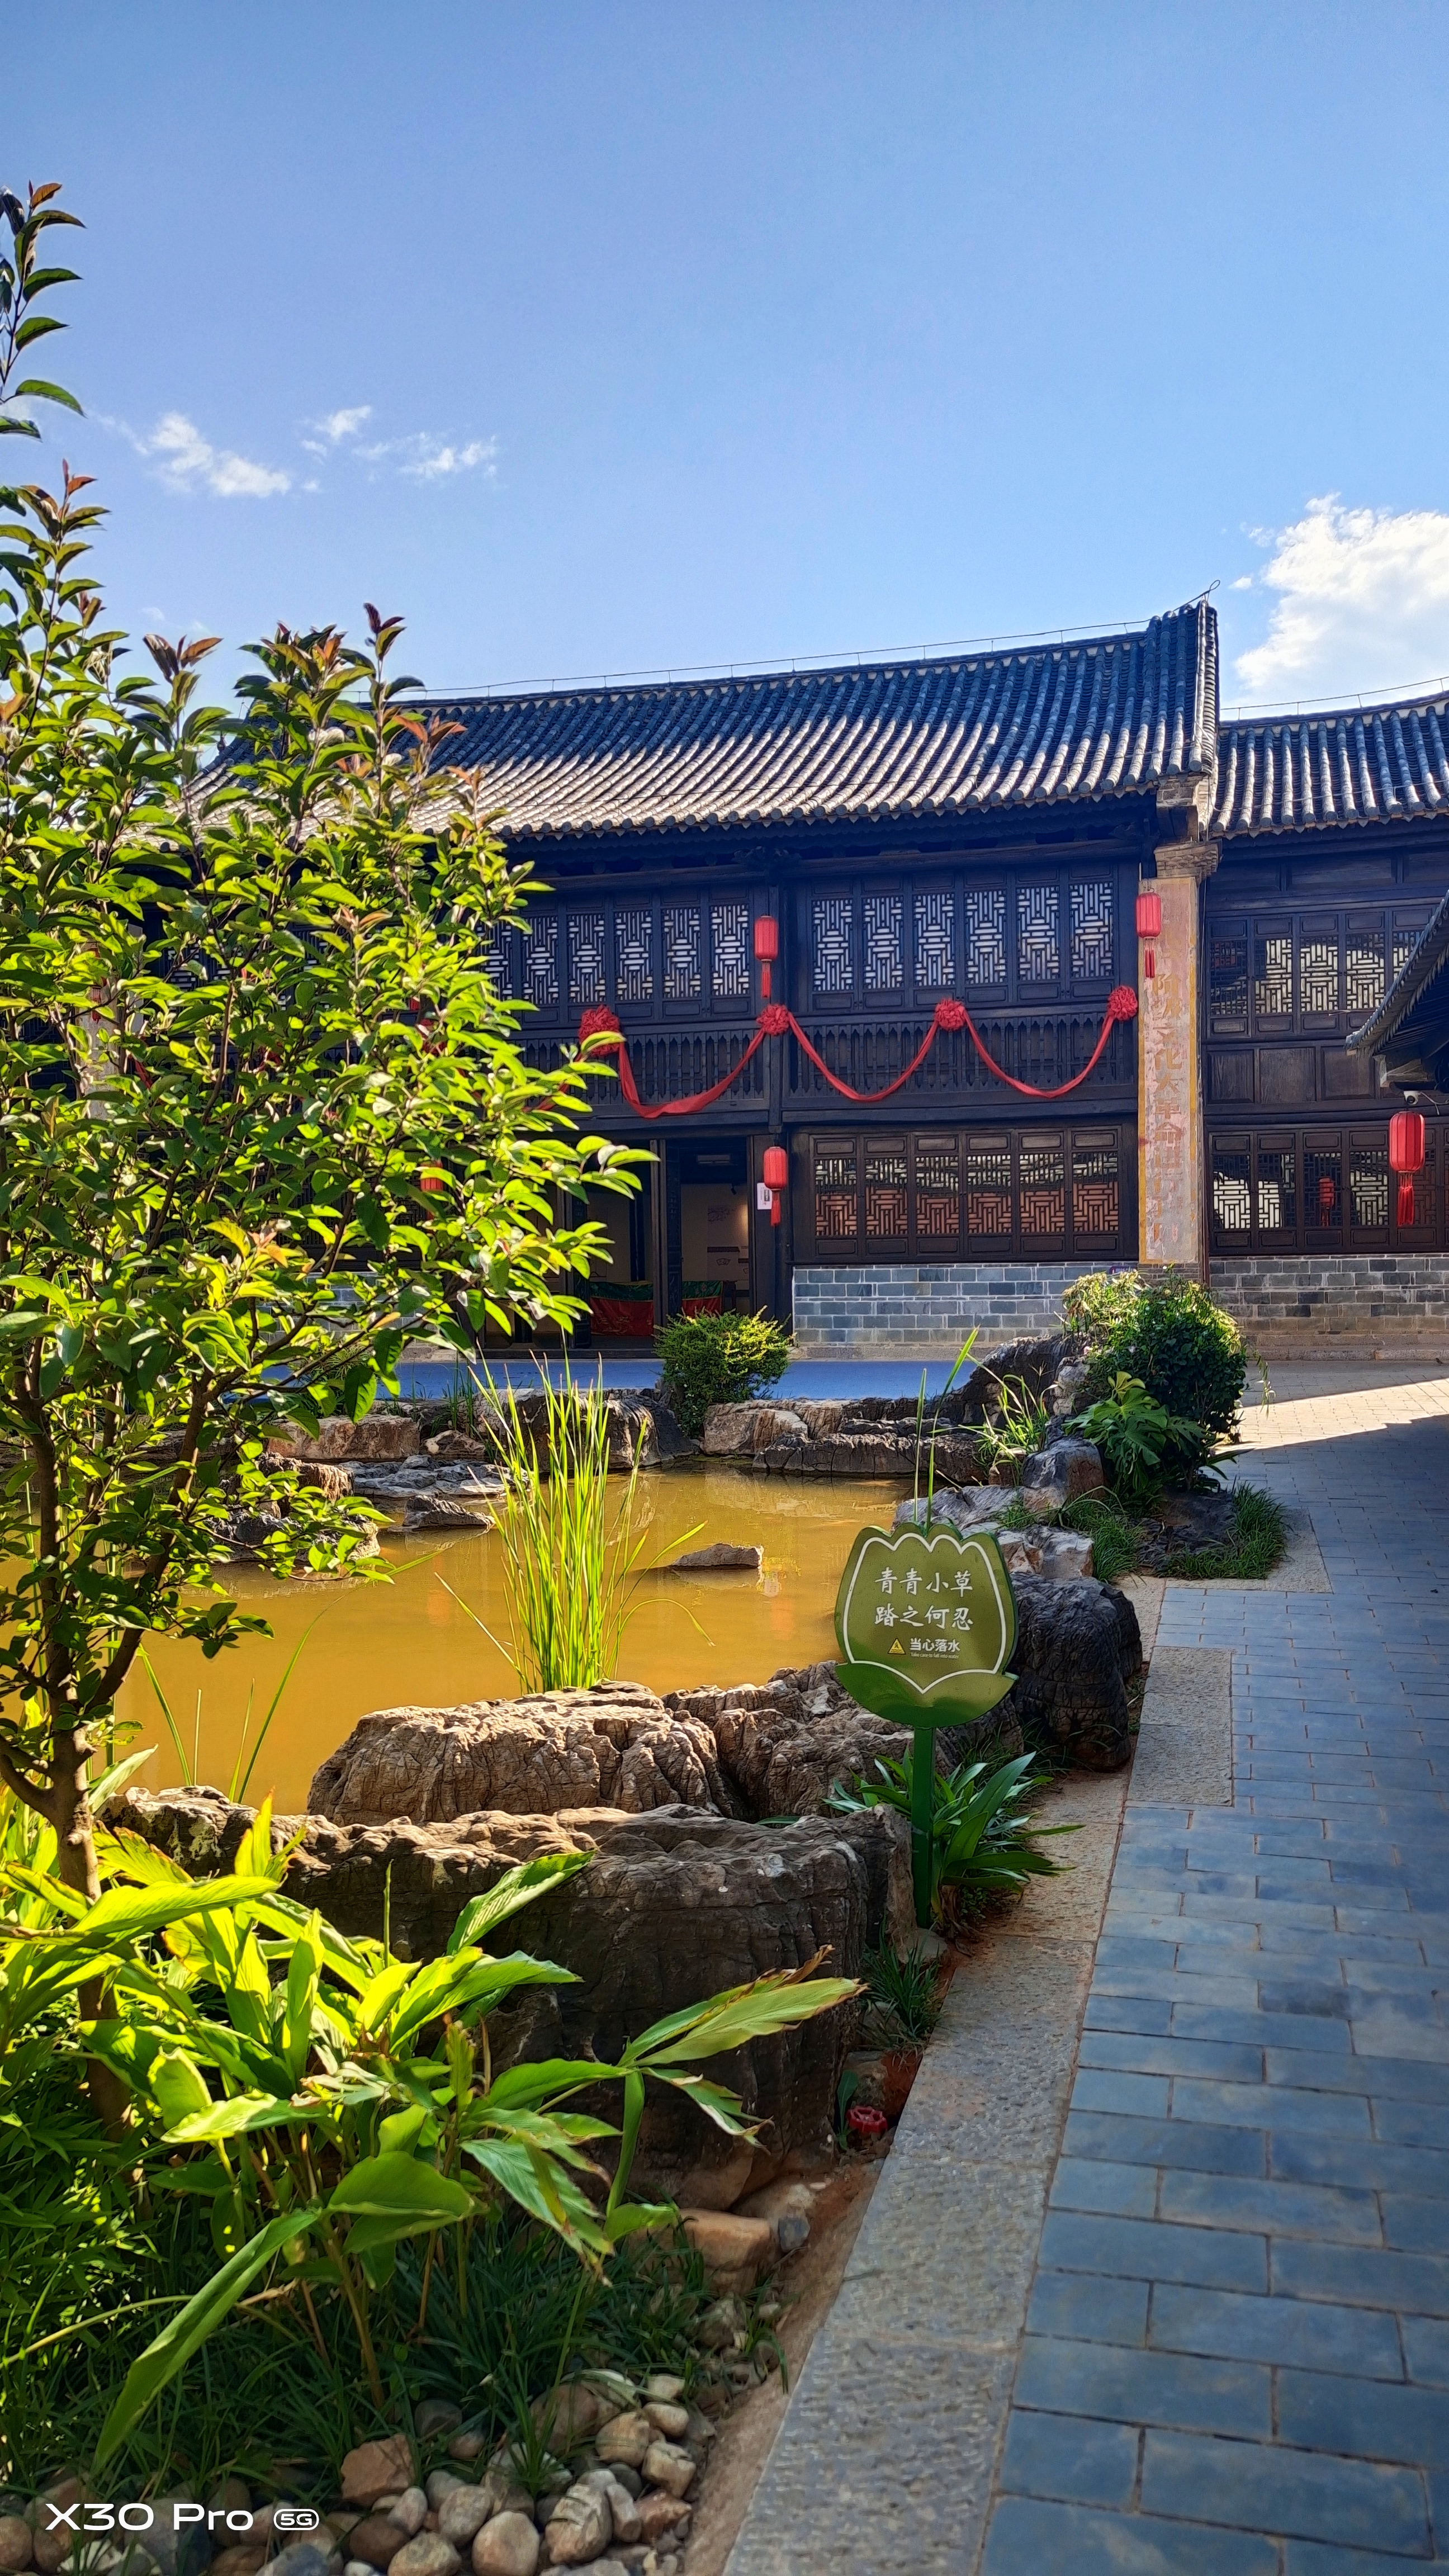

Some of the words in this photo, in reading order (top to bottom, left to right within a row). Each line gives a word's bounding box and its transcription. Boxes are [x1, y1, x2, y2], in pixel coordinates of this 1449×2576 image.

[874, 1566, 973, 1597] 青青小草
[874, 1603, 974, 1631] 踏之何忍
[910, 1637, 961, 1652] 当心落水
